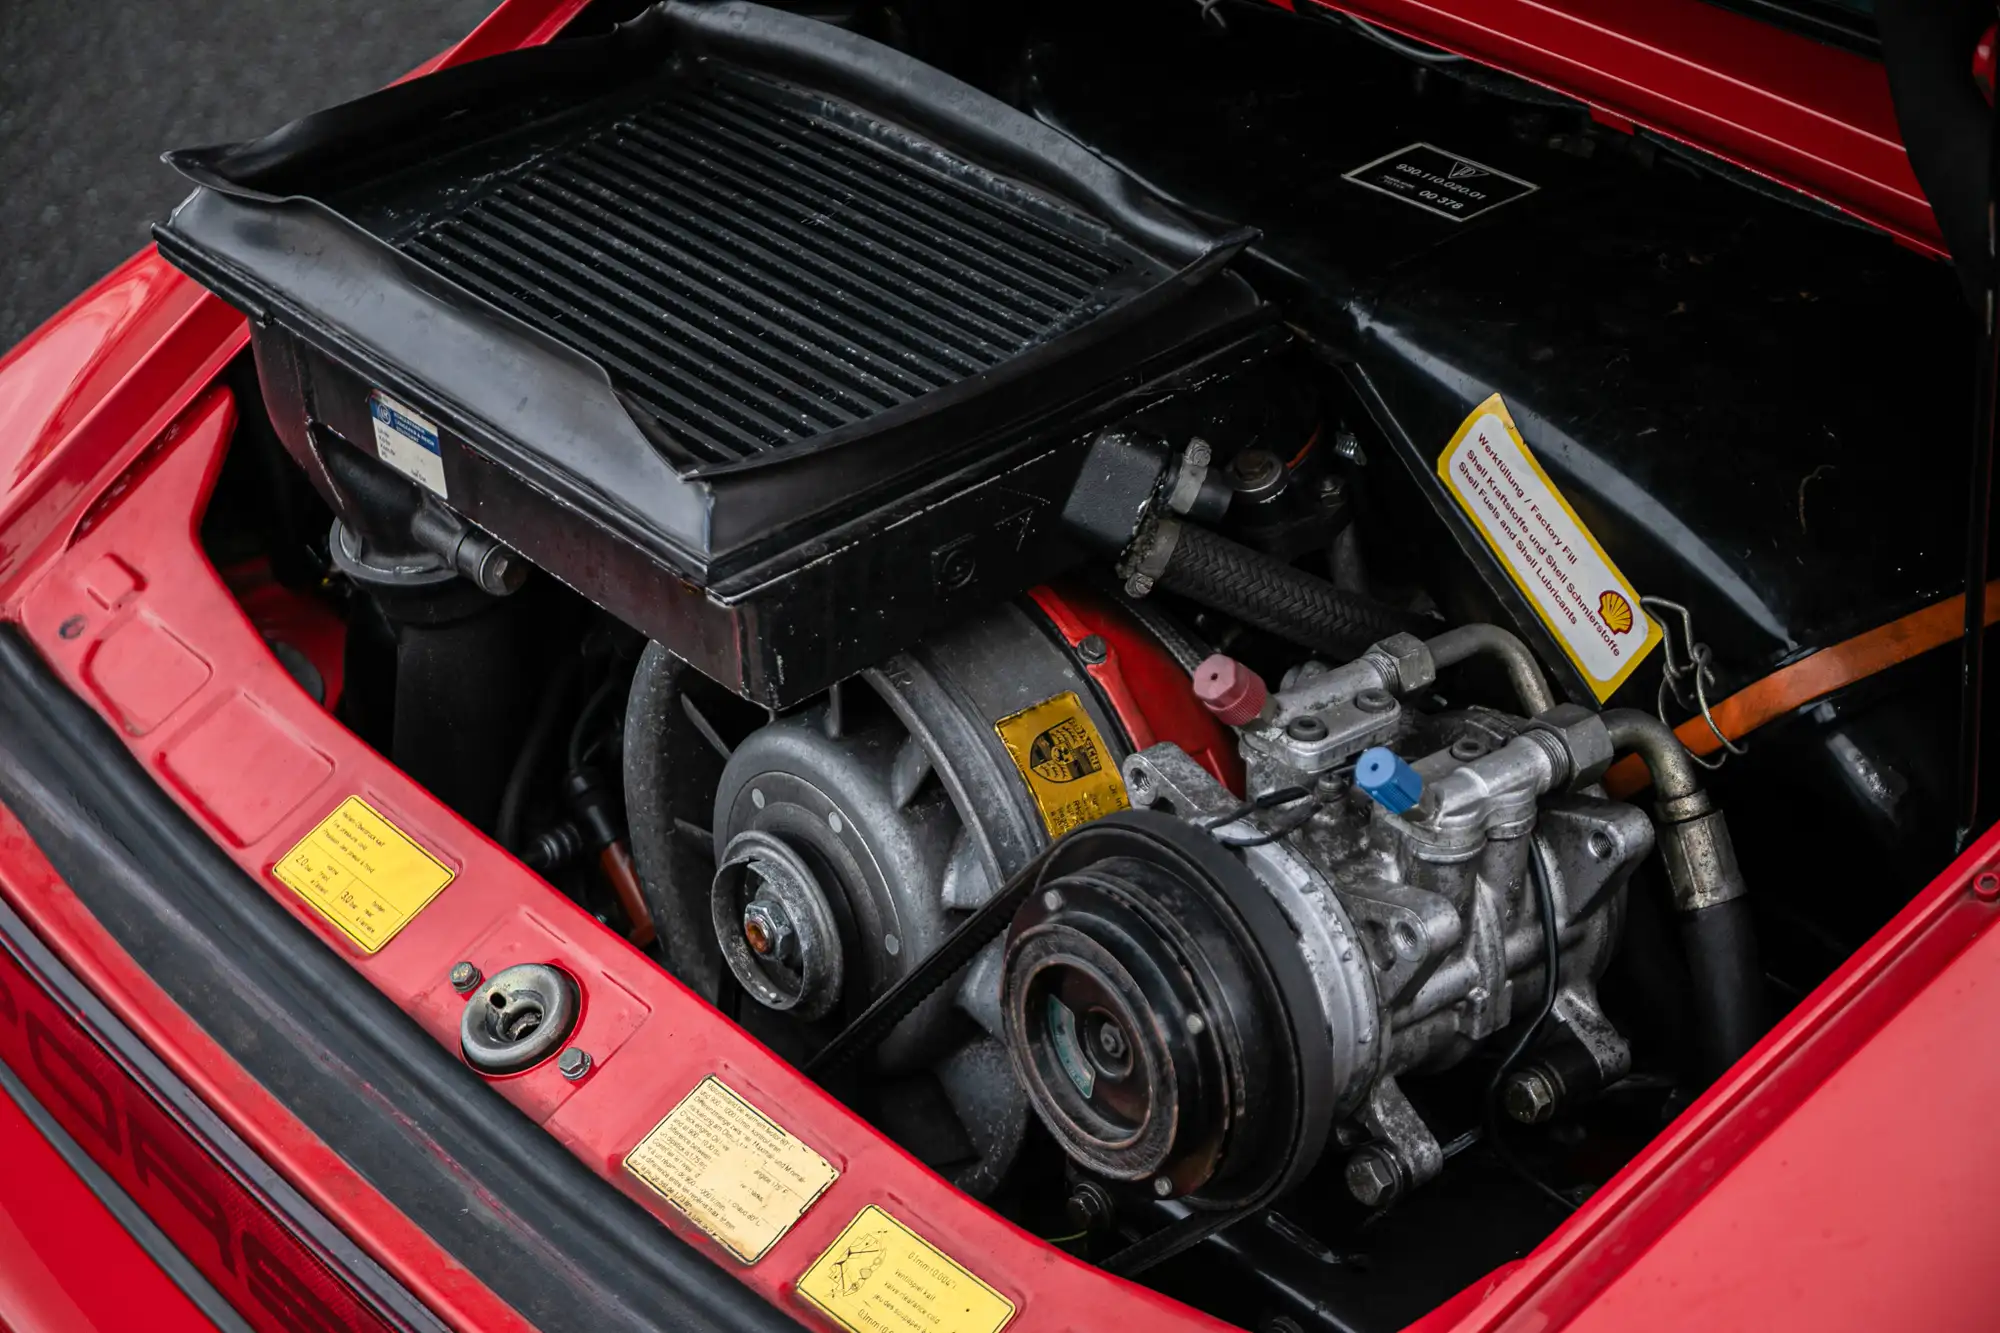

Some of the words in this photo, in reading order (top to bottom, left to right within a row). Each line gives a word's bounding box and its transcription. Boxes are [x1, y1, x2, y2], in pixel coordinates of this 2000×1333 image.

[1396, 163, 1486, 200] 930.110.020.01
[1419, 190, 1438, 200] 00
[1437, 196, 1464, 209] 378
[1476, 431, 1526, 499] Werkfüllung
[1529, 502, 1563, 548] Factory
[1561, 544, 1577, 566] Fill
[1457, 460, 1480, 491] Shell
[1477, 487, 1502, 520] Fuels
[1499, 517, 1517, 541] and
[1515, 538, 1538, 569] Shell
[1535, 566, 1579, 626] Lubricants
[1465, 447, 1489, 478] Shell
[1486, 475, 1530, 535] Kraftstoffe
[1528, 531, 1547, 556] und
[1544, 552, 1568, 584] Shell
[1565, 580, 1622, 658] Schmierstoffe
[1069, 717, 1102, 770] PORSCHE
[872, 1293, 884, 1302] jeu
[882, 1300, 894, 1310] des
[892, 1308, 922, 1330] soupapes
[883, 1281, 900, 1294] valve
[898, 1291, 928, 1314] clearance
